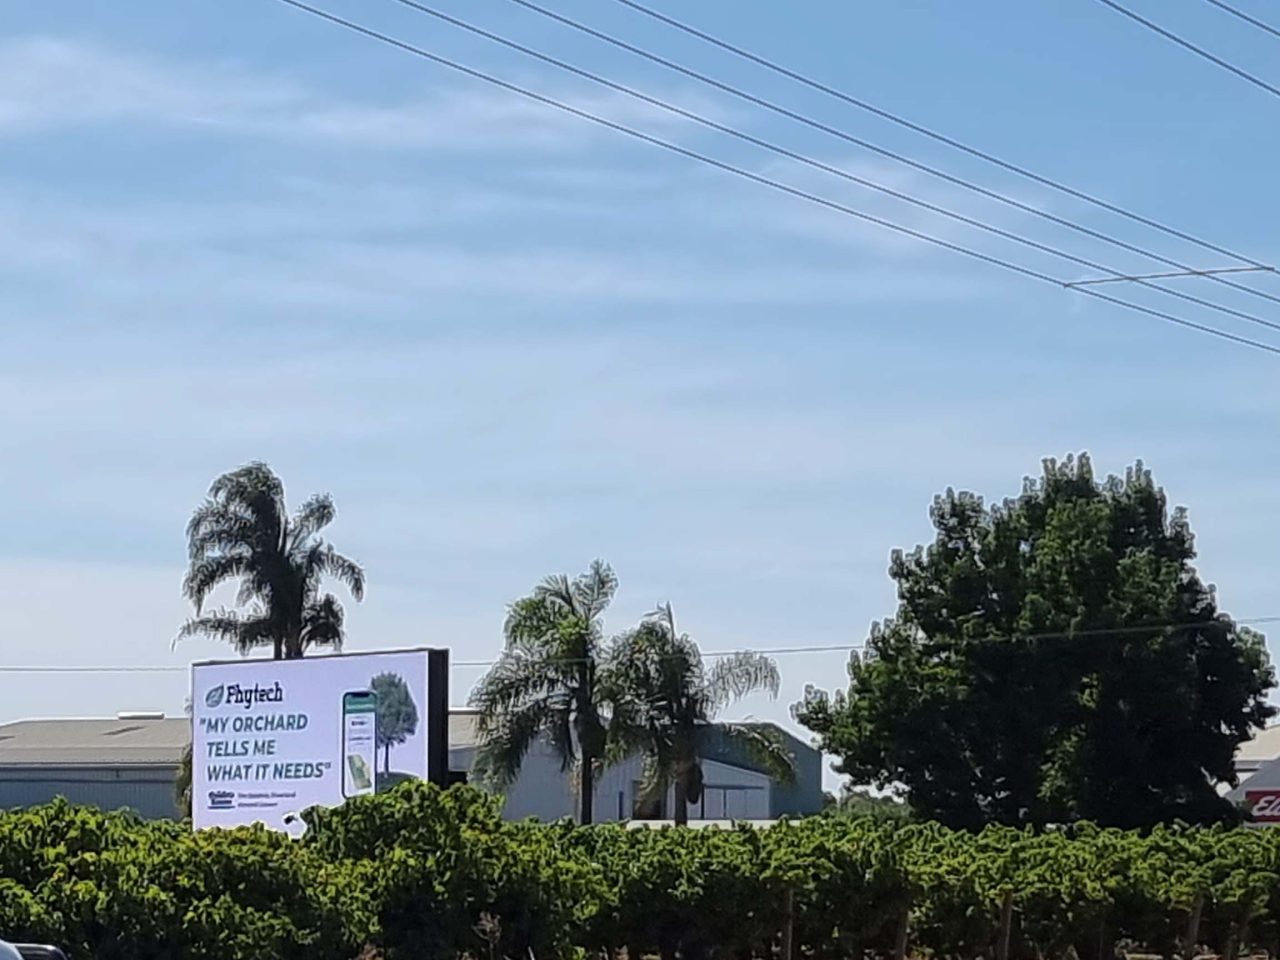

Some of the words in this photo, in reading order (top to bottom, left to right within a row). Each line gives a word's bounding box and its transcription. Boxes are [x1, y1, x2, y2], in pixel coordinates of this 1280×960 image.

[200, 717, 229, 734] "MY
[232, 714, 308, 733] ORCHARD
[207, 740, 249, 758] TELLS
[253, 739, 275, 756] ME
[207, 765, 253, 782] WHAT
[255, 764, 269, 780] IT
[273, 762, 332, 780] NEEDS"
